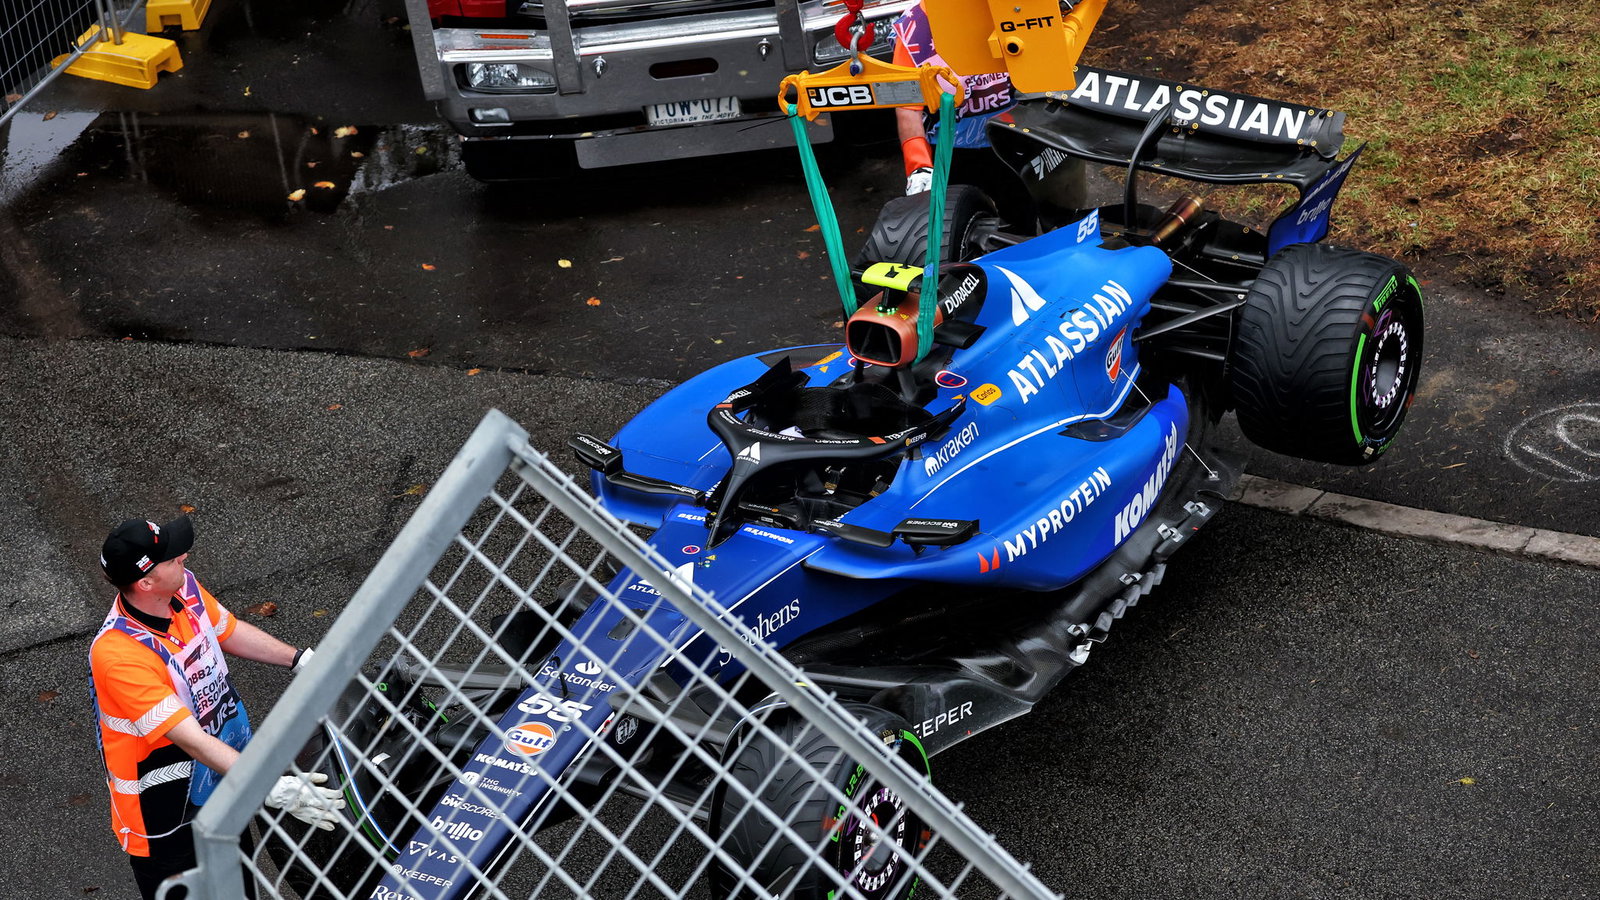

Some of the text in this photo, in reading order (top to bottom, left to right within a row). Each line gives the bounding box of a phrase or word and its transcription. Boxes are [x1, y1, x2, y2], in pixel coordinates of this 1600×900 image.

[1000, 16, 1054, 33] Q-FIT
[810, 86, 872, 107] JCB
[1072, 71, 1306, 139] ATLASSIAN
[1076, 209, 1099, 244] 55
[945, 272, 980, 314] DURACELL
[1373, 275, 1398, 313] PIRELLI
[1007, 279, 1133, 404] ATLASSIAN
[1003, 466, 1112, 563] MYPROTEIN
[628, 584, 663, 597] ATLAS
[541, 666, 617, 693] Santander
[518, 691, 594, 723] 55
[507, 730, 553, 748] Gulf
[617, 717, 638, 742] FIA
[402, 868, 453, 889] KEEPER
